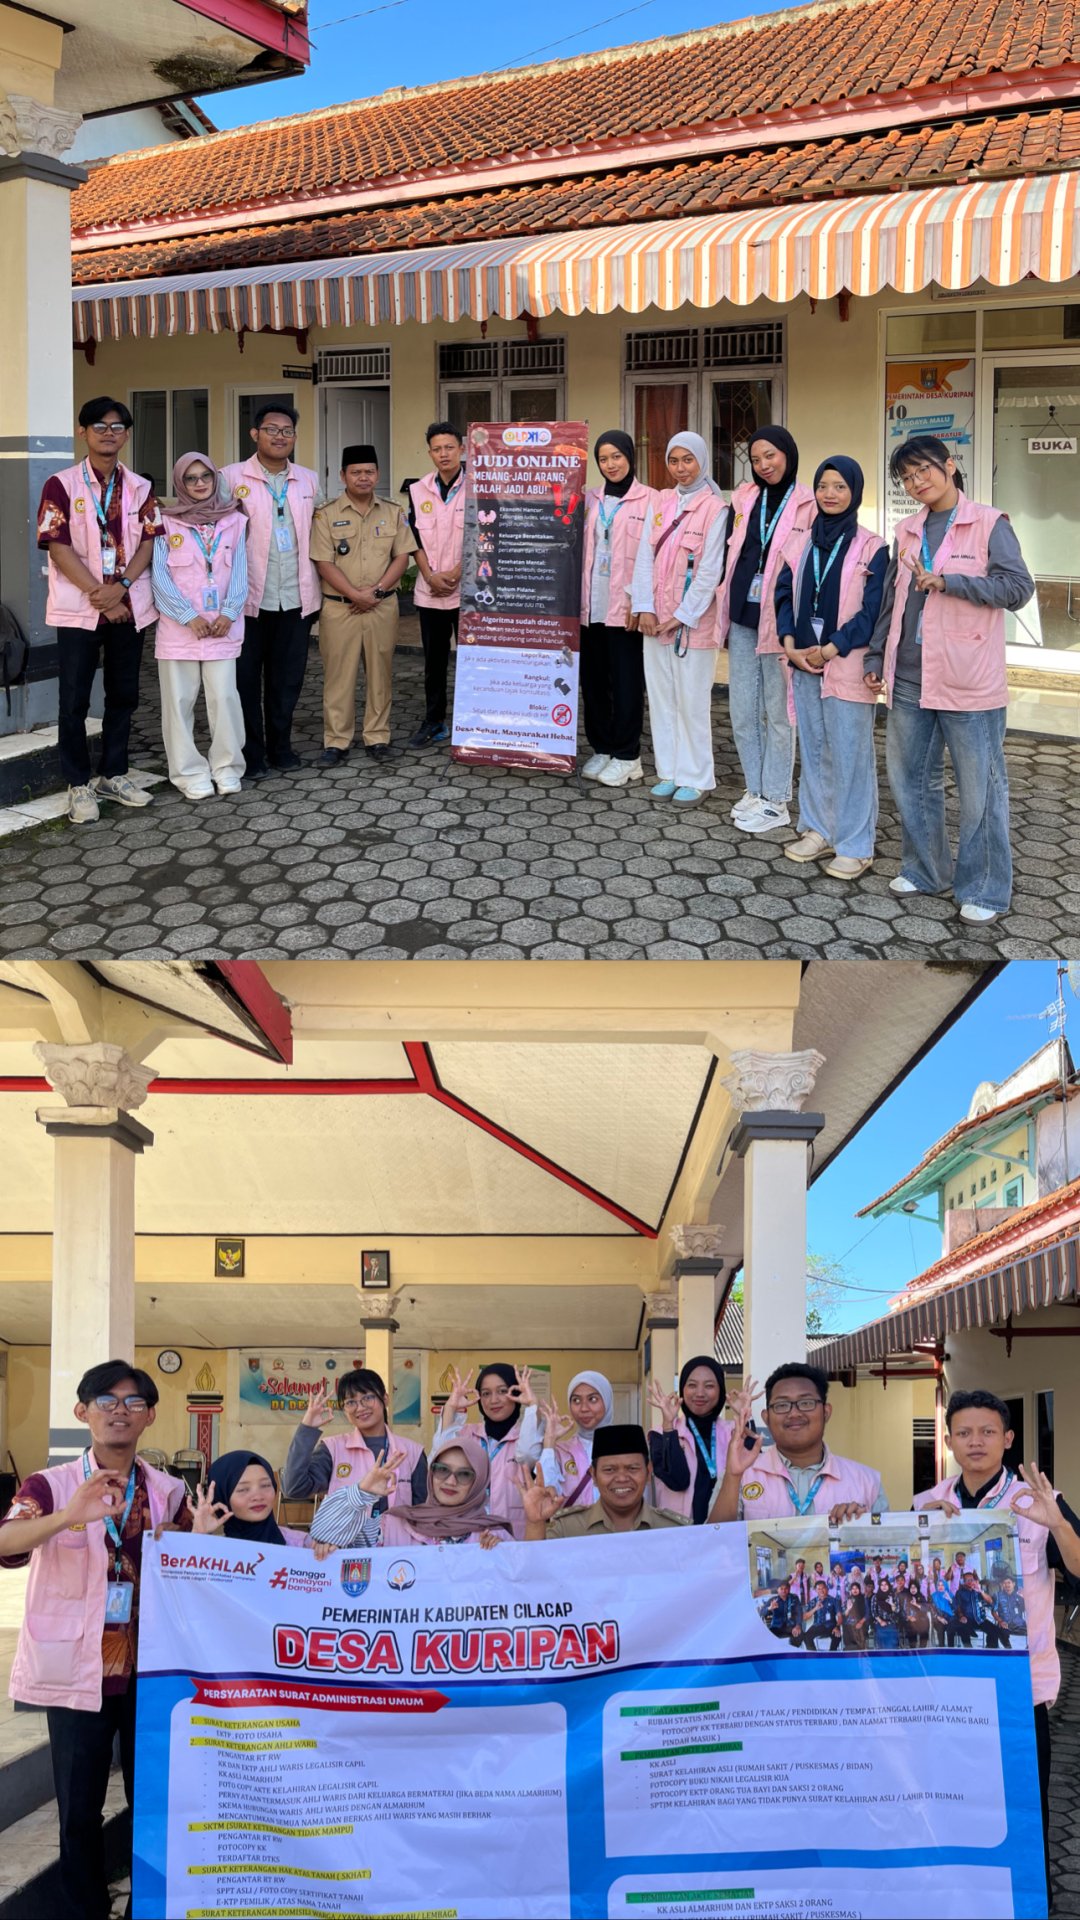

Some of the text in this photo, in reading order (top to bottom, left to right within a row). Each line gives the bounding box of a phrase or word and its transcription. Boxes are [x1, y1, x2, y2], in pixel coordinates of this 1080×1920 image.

[888, 405, 907, 420] 10
[1032, 441, 1072, 450] BUKA
[472, 455, 581, 468] JUDI ONLINE
[473, 472, 567, 484] MENANG JADI ARANG,
[473, 484, 547, 494] KALAH JADI ABU!
[268, 1376, 329, 1395] Selamat
[271, 1400, 285, 1410] DI
[160, 1553, 257, 1575] BerAKHLAK
[289, 1568, 326, 1579] bangga
[287, 1577, 332, 1587] melayani
[287, 1584, 323, 1593] bangsa
[322, 1602, 573, 1624] PEMERINTAH KABUPATEN CILACAP
[273, 1620, 620, 1675] DESA KURIPAN
[203, 1687, 424, 1707] PERSYARATAN SURAT ADMINISTRASI UMUM
[675, 1716, 702, 1724] STATUS
[703, 1713, 725, 1721] NIKAH
[791, 1708, 838, 1716] PENDIDIKAN
[940, 1705, 972, 1713] ALAMAT
[204, 1718, 224, 1727] SURAT
[224, 1720, 274, 1729] KETERANGAN
[662, 1726, 700, 1736] FOTOCOPY
[711, 1722, 743, 1730] TERBARU
[745, 1720, 774, 1728] DENGAN
[775, 1719, 802, 1727] STATUS
[257, 1731, 282, 1739] USAHA
[205, 1739, 225, 1748] SURAT
[226, 1741, 273, 1750] KETERANGAN
[218, 1751, 255, 1761] PENGANTAR
[268, 1753, 281, 1761] RW
[241, 1764, 257, 1772] EKTP
[259, 1764, 278, 1773] AHLI
[279, 1763, 304, 1771] WARIS
[305, 1761, 343, 1770] LEGALISIR
[219, 1781, 235, 1789] FOTO
[237, 1783, 252, 1791] COPY
[254, 1785, 271, 1793] AKTE
[272, 1784, 316, 1794] KELAHIRAN
[318, 1782, 356, 1791] LEGALISIR
[650, 1779, 688, 1789] FOTOCOPY
[689, 1777, 709, 1785] BUKU
[710, 1776, 734, 1784] NIKAH
[367, 1789, 562, 1799] KELUARGA BERMATERAI (JIKA BEDA NAMA ALMARHUM)
[690, 1788, 709, 1796] EKTP
[710, 1787, 735, 1795] ORANG
[737, 1786, 752, 1794] TUA
[753, 1785, 770, 1793] BAYI
[772, 1785, 787, 1793] DAN
[305, 1804, 323, 1815] AHLI
[325, 1804, 349, 1813] WARIS
[351, 1802, 381, 1811] DENGAN
[301, 1818, 324, 1826] NAMA
[326, 1816, 342, 1824] DAN
[343, 1814, 373, 1823] BERKAS
[393, 1812, 416, 1820] WARIS
[417, 1812, 437, 1820] YANG
[462, 1811, 492, 1819] BERHAK
[203, 1823, 225, 1831] SKTM
[253, 1824, 295, 1836] KETERANGAN
[297, 1827, 321, 1837] TIDAK
[217, 1854, 261, 1863] TERDAFTAR
[202, 1865, 227, 1873] SURAT
[229, 1865, 277, 1874] KETERANGAN
[279, 1867, 293, 1875] HAK
[311, 1870, 336, 1879] TANAH
[657, 1899, 833, 1914] KK ASLI ALMARHUM DAN EKTP SAKSI ORANG
[201, 1909, 226, 1918] SURAT
[227, 1908, 277, 1918] KETERANGAN
[278, 1908, 311, 1917] DOMISILI
